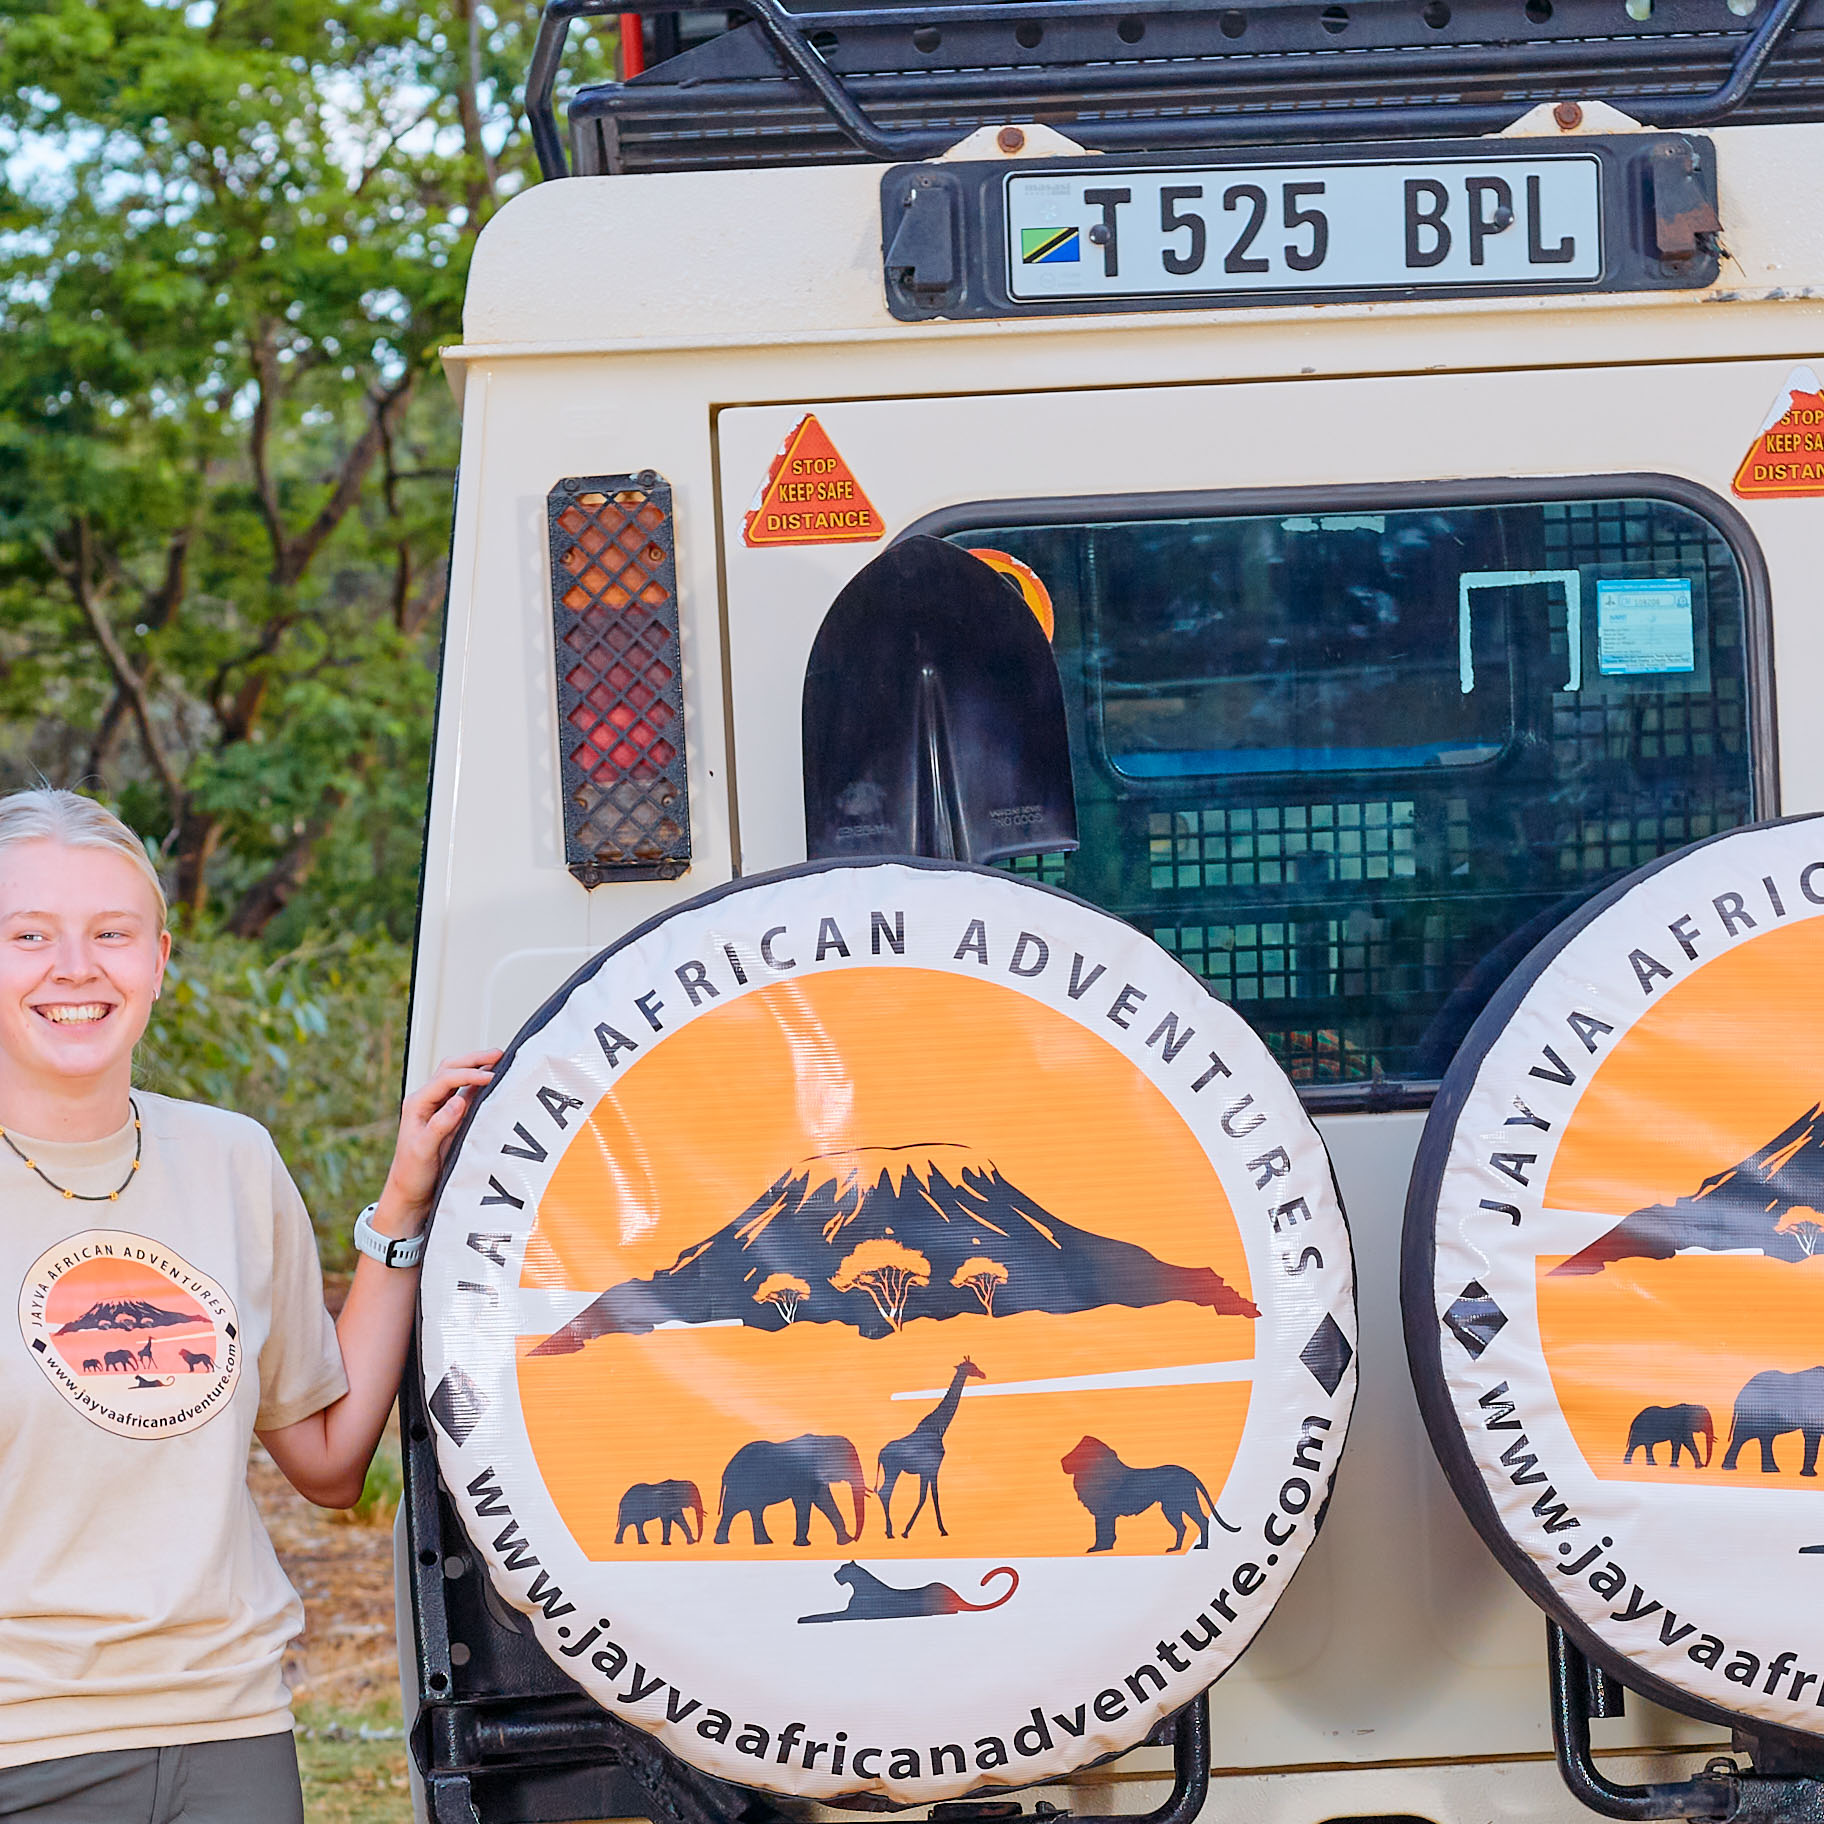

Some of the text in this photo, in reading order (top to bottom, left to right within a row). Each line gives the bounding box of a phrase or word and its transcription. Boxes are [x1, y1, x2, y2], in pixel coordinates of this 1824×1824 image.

[1083, 174, 1576, 279] T 525 BPL
[1766, 433, 1801, 453] KEEP
[1780, 409, 1824, 426] STOP
[779, 481, 853, 502] KEEP SAFE
[792, 458, 837, 475] STOP
[767, 510, 871, 531] DISTANCE
[457, 911, 1325, 1307] JAYVA AFRICAN ADVENTURES
[1481, 1009, 1615, 1226] JAYVA
[31, 1245, 226, 1327] JAYVA AFRICAN ADVENTURES
[46, 1344, 236, 1429] www.jayvaafricanadventure.com
[466, 1415, 1333, 1780] www.jayvaafricanadventure.com
